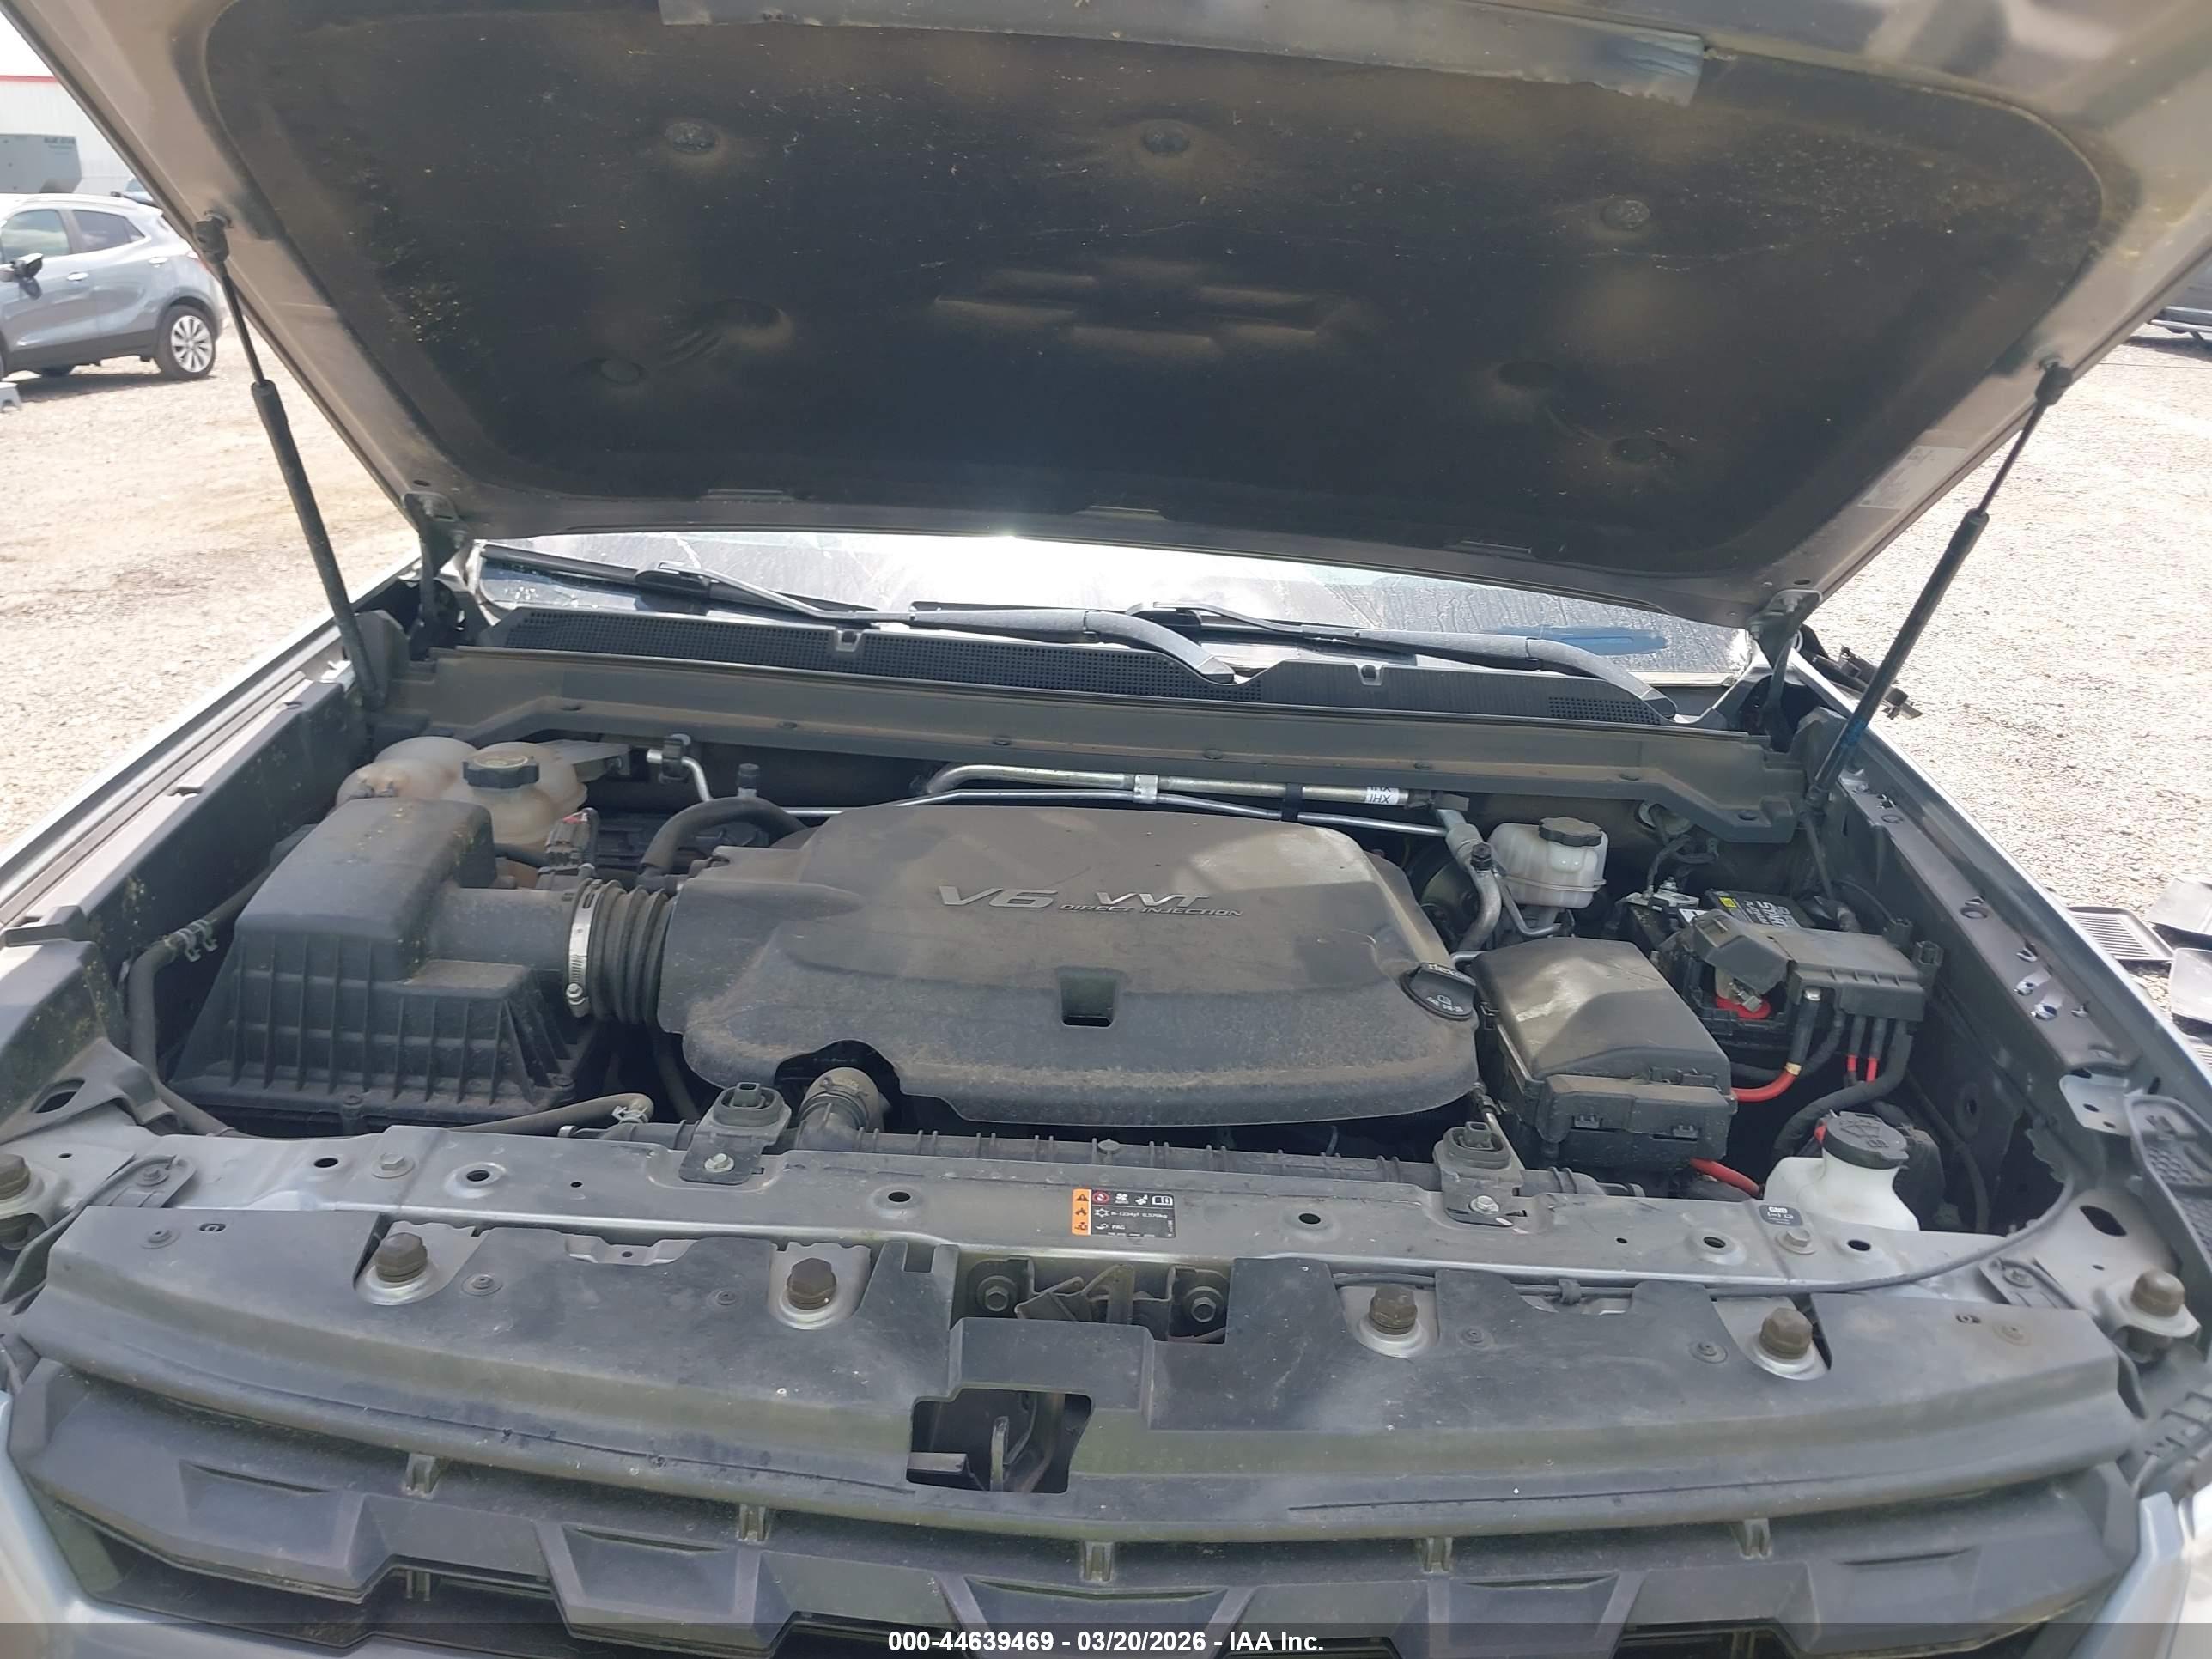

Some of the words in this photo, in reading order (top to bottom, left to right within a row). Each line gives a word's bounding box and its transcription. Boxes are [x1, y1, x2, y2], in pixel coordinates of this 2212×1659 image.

[939, 885, 1059, 908] V6
[1097, 892, 1210, 907] VVT
[1060, 904, 1135, 913] DIRECT
[1141, 908, 1245, 917] INJECTION
